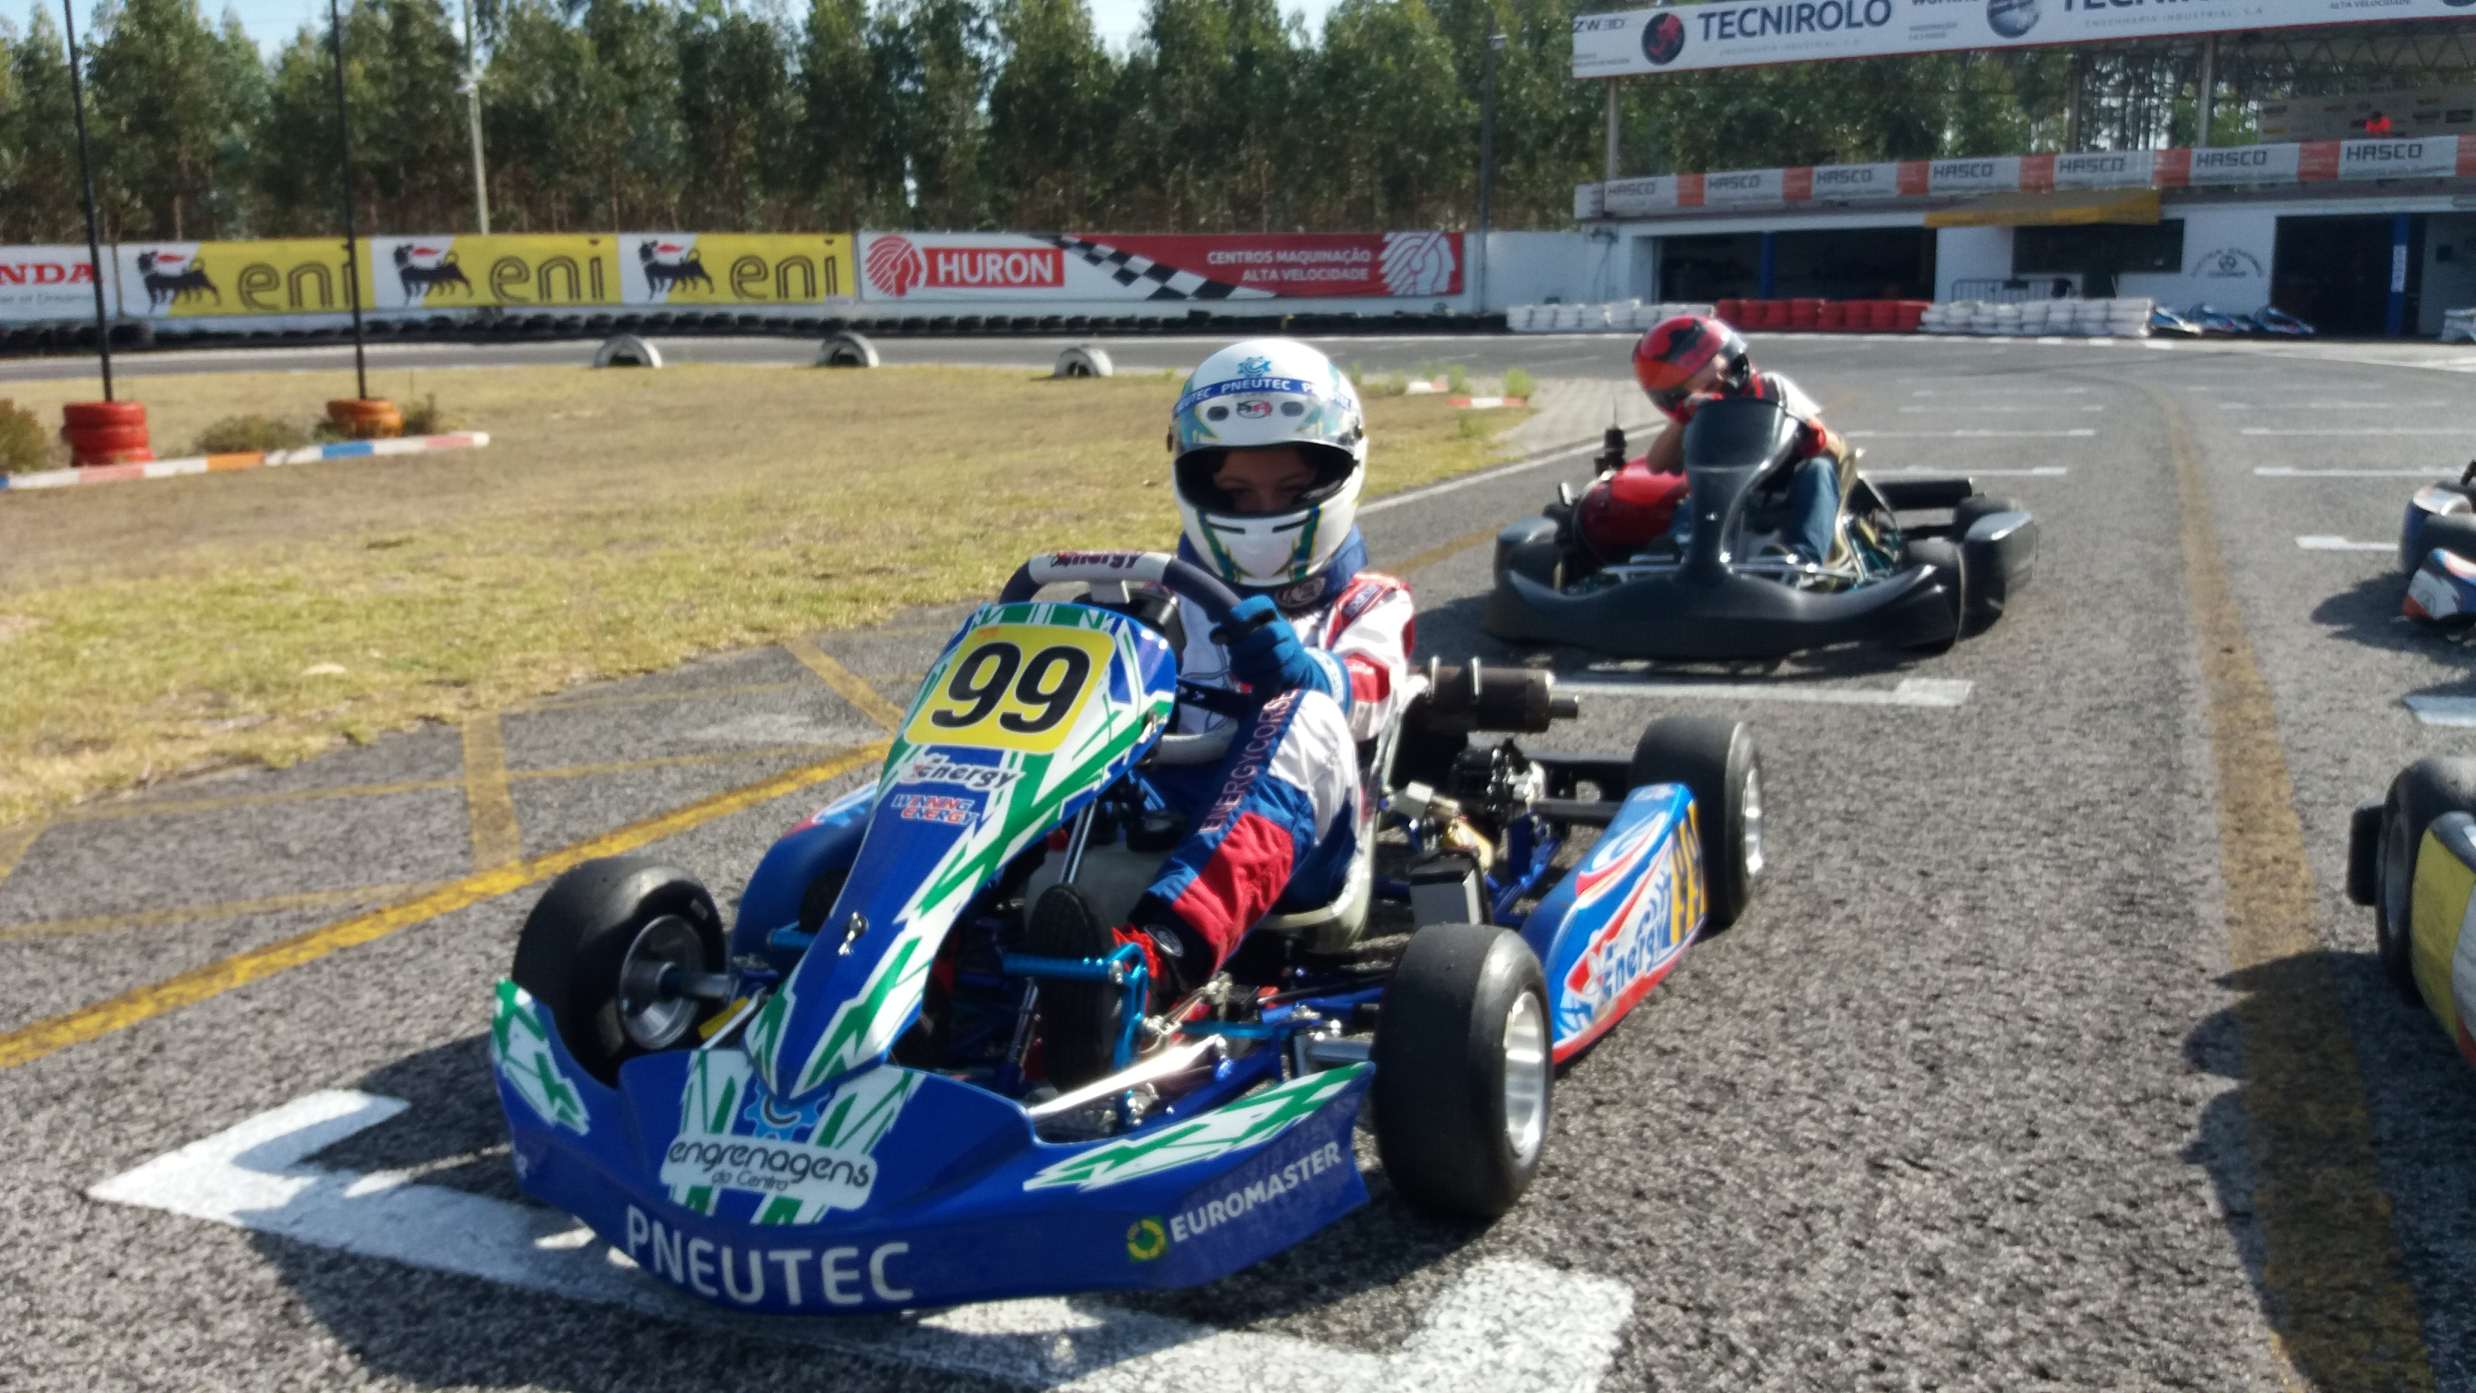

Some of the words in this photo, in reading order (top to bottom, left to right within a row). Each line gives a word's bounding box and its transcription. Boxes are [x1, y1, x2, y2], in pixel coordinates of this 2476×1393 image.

[1697, 0, 1891, 42] TECNIROLO
[2195, 150, 2268, 168] HASCO
[2345, 143, 2424, 161] HASCO
[1932, 162, 1994, 181] HASCO
[2058, 155, 2126, 174] HASCO
[1708, 174, 1761, 191] HASCO
[1815, 167, 1873, 185] HASCO
[1607, 181, 1657, 197] HASCO
[1206, 251, 1273, 265] CENTROS
[1275, 248, 1372, 266] MAQUINAÇÃO
[236, 243, 357, 312] eni
[488, 238, 603, 301] eni
[729, 238, 839, 301] eni
[936, 252, 1052, 284] HURON
[1241, 268, 1279, 282] ALTA
[1282, 267, 1369, 281] VELOCIDADE
[1221, 378, 1292, 394] PNEUTEC
[931, 641, 1091, 734] 99
[667, 1139, 870, 1189] engrenagens
[711, 1168, 733, 1187] do
[736, 1168, 789, 1192] Centro
[1168, 1140, 1343, 1243] EUROMASTER
[626, 1204, 915, 1305] PNEUTEC
